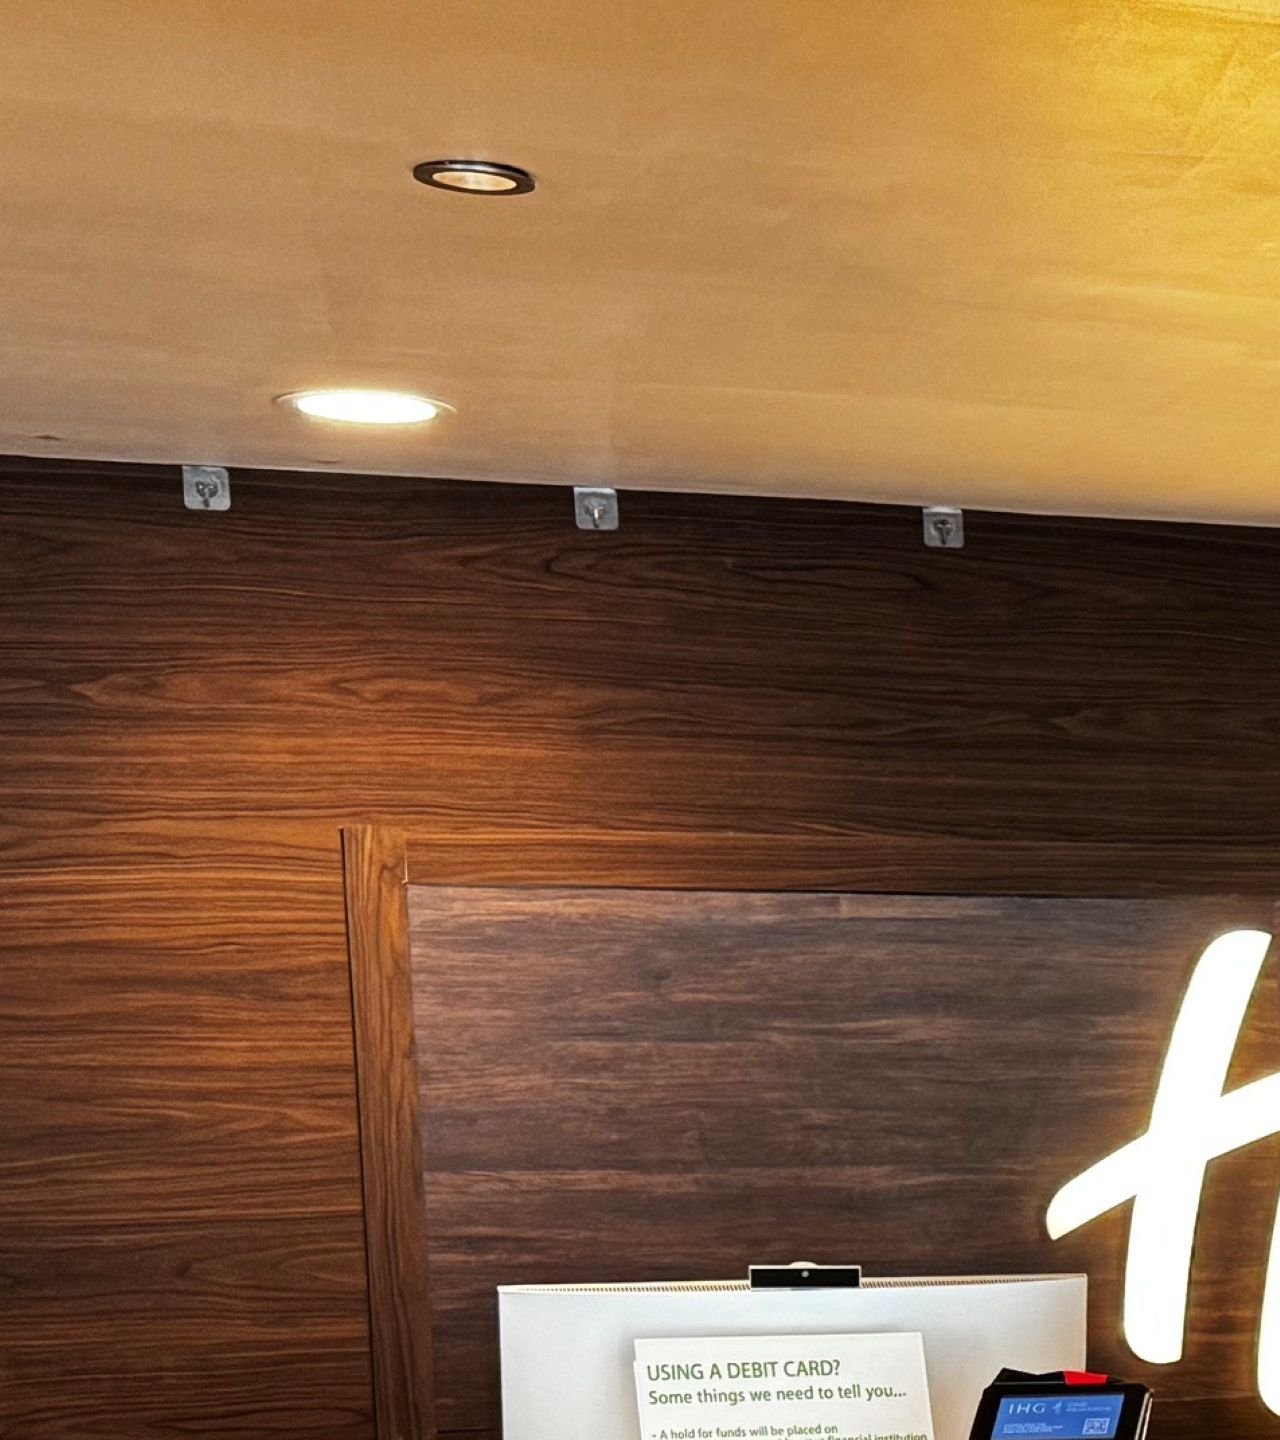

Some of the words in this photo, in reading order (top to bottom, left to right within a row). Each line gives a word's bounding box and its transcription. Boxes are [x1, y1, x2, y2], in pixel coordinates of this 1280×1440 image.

[647, 1363, 704, 1381] USING
[710, 1363, 722, 1379] A
[727, 1361, 778, 1379] DEBIT
[784, 1359, 840, 1377] CARD?
[649, 1390, 692, 1405] Some
[697, 1389, 745, 1406] things
[750, 1390, 771, 1401] we
[776, 1386, 813, 1400] need
[818, 1387, 834, 1400] to
[838, 1384, 861, 1399] tell
[865, 1386, 907, 1402] you...
[1009, 1402, 1046, 1414] IHG
[660, 1430, 668, 1440] A
[670, 1428, 696, 1439] hold
[698, 1428, 713, 1438] for
[716, 1426, 747, 1438] funds
[749, 1426, 768, 1436] will
[770, 1425, 784, 1436] be
[787, 1424, 821, 1436] placed
[824, 1426, 838, 1434] on
